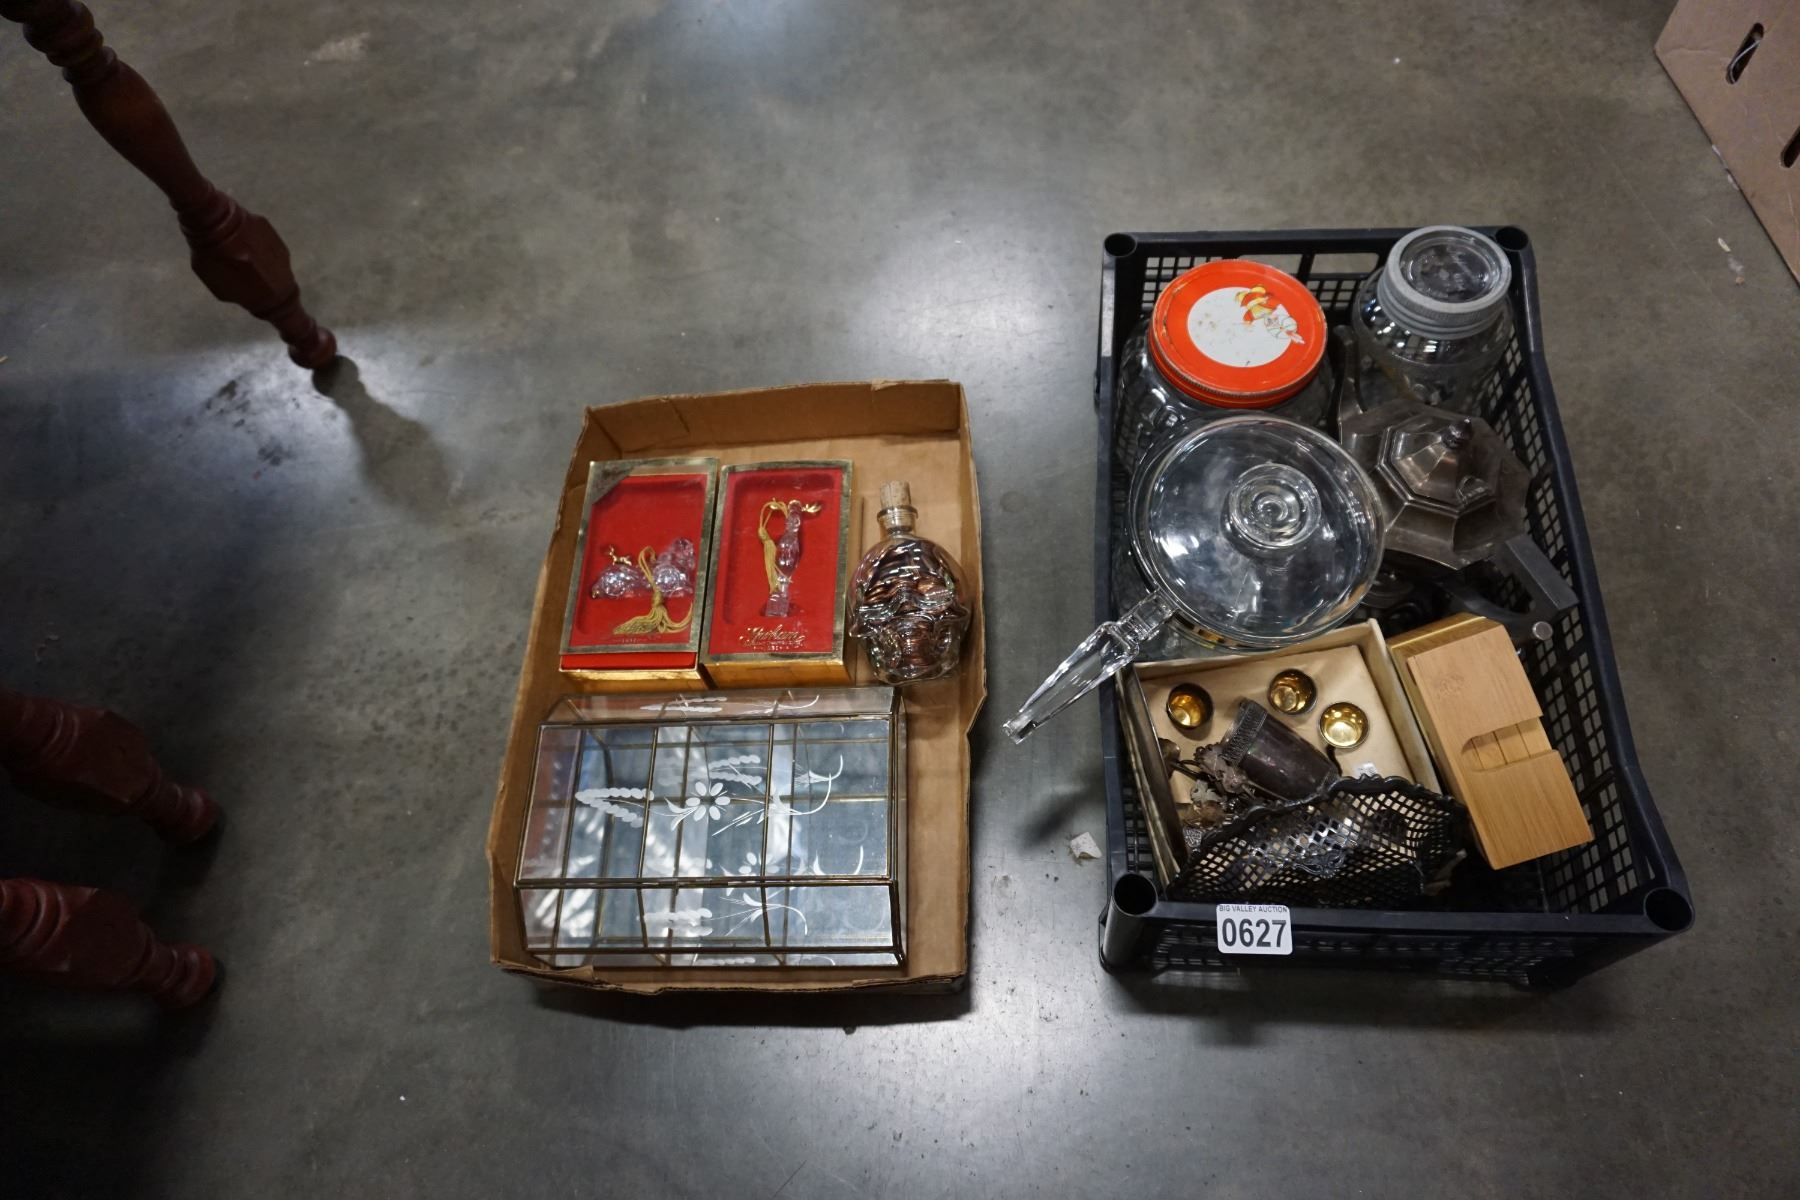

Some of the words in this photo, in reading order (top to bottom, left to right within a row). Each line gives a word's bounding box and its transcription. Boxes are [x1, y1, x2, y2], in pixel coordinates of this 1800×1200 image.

[1219, 904, 1231, 912] BIG
[1258, 905, 1288, 913] AUCTION
[1222, 917, 1287, 948] 0627
